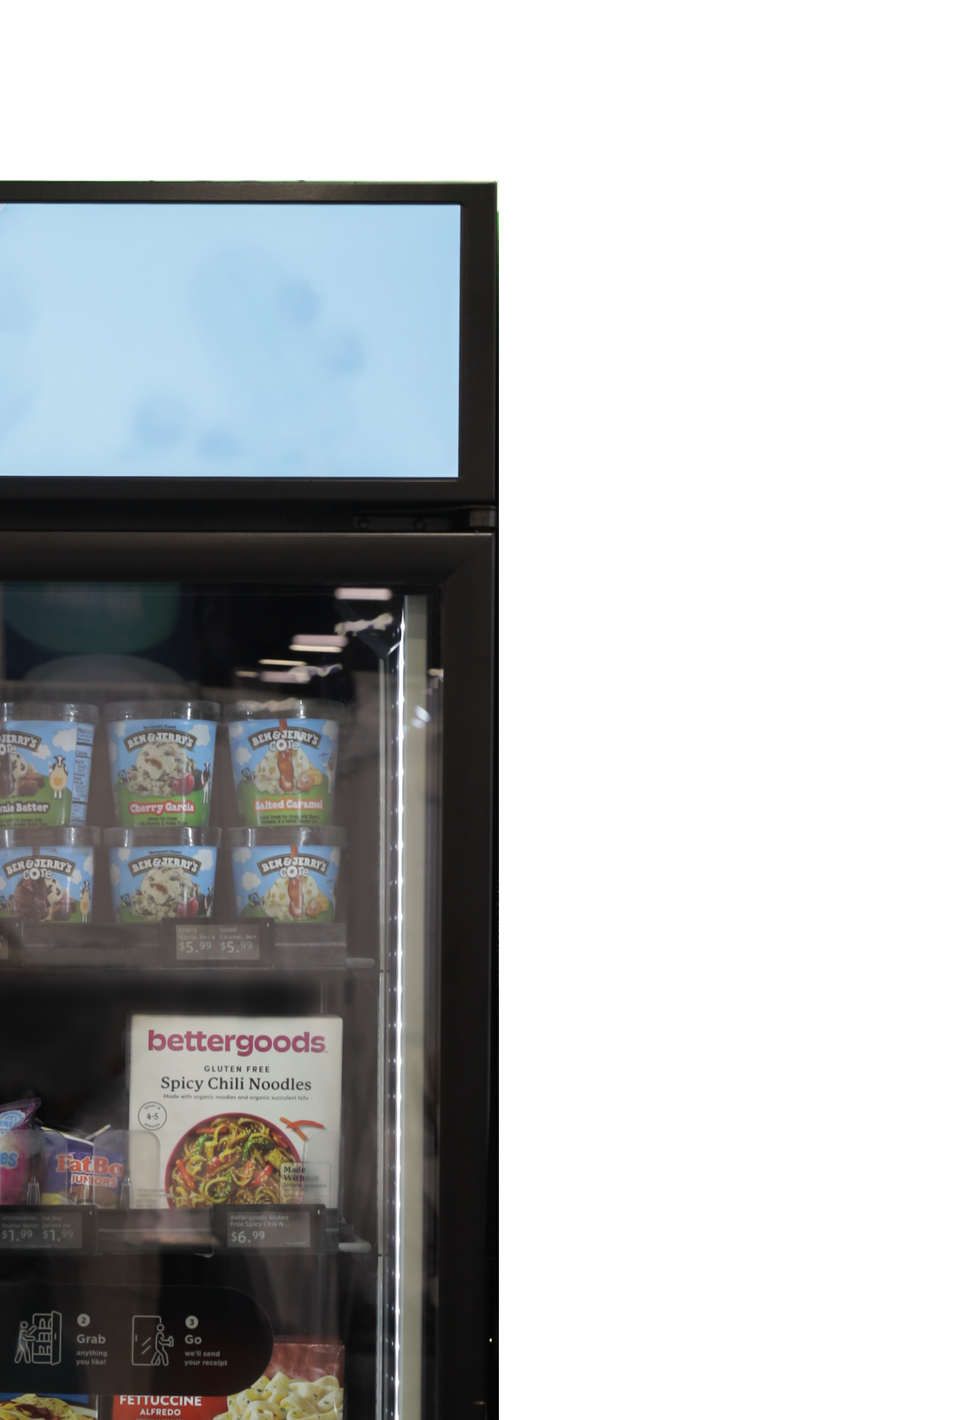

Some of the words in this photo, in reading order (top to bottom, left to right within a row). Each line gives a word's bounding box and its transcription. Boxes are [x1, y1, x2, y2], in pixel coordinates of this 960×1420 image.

[129, 803, 164, 815] Cherry
[165, 802, 195, 812] Garcia
[255, 800, 284, 810] Salted
[286, 799, 323, 809] Caramel
[179, 941, 212, 954] $5.99
[220, 941, 253, 954] $5.99
[148, 1030, 326, 1057] bettergoods
[204, 1065, 243, 1073] GLUTEN
[246, 1065, 271, 1073] FREE
[160, 1076, 204, 1092] Spicy
[208, 1077, 245, 1090] Chili
[249, 1077, 312, 1091] Noodles
[146, 1112, 159, 1120] 4-5
[283, 1166, 306, 1174] Made
[70, 1174, 117, 1188] JUNIORS
[2, 1229, 33, 1242] $1.99
[43, 1229, 74, 1242] $1.99
[231, 1230, 265, 1244] $6.99
[76, 1333, 106, 1345] Grab
[184, 1334, 202, 1345] Go
[76, 1350, 108, 1358] anything
[119, 1395, 202, 1407] FETTUCCINE
[139, 1408, 182, 1416] ALFREDO
